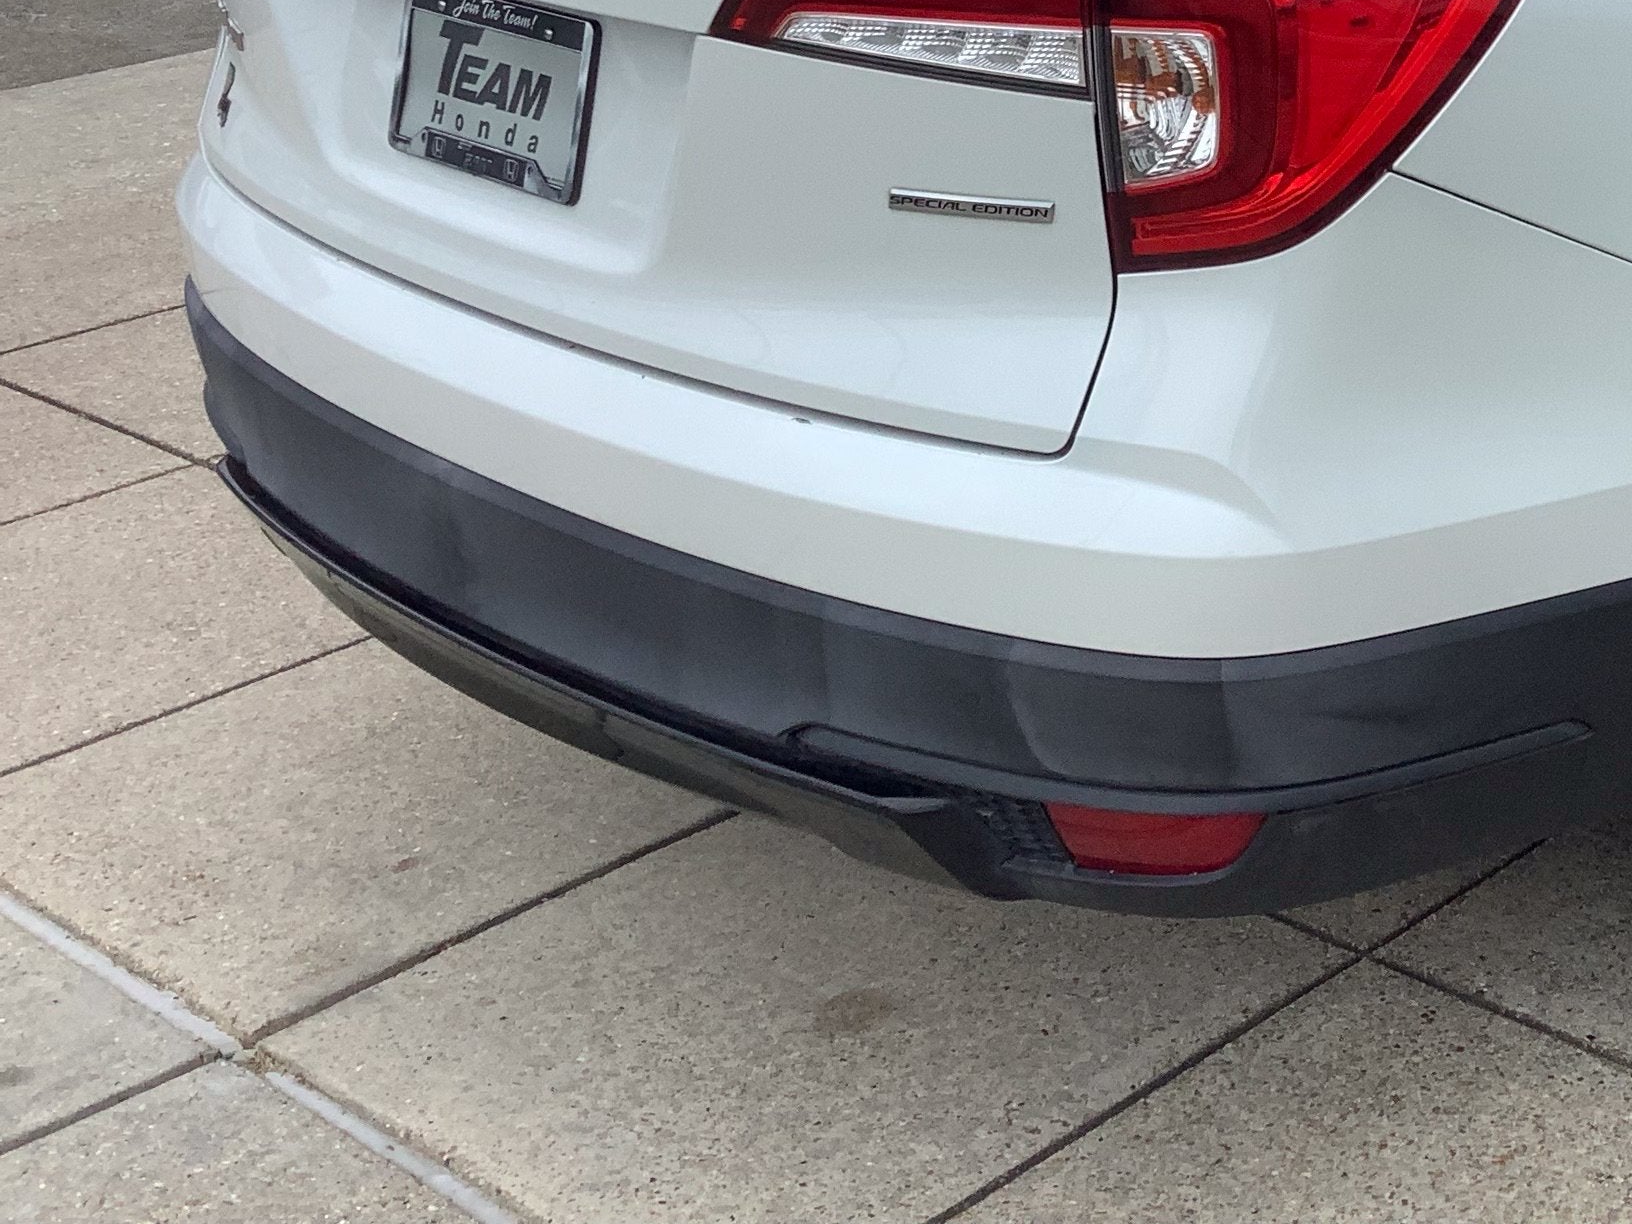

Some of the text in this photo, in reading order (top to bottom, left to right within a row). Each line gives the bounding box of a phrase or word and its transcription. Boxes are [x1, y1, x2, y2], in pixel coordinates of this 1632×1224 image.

[481, 0, 502, 21] The
[502, 5, 539, 31] Team!
[437, 19, 553, 122] TEAM
[431, 99, 540, 154] Honda
[889, 194, 1049, 219] SPECIAL EDITION
